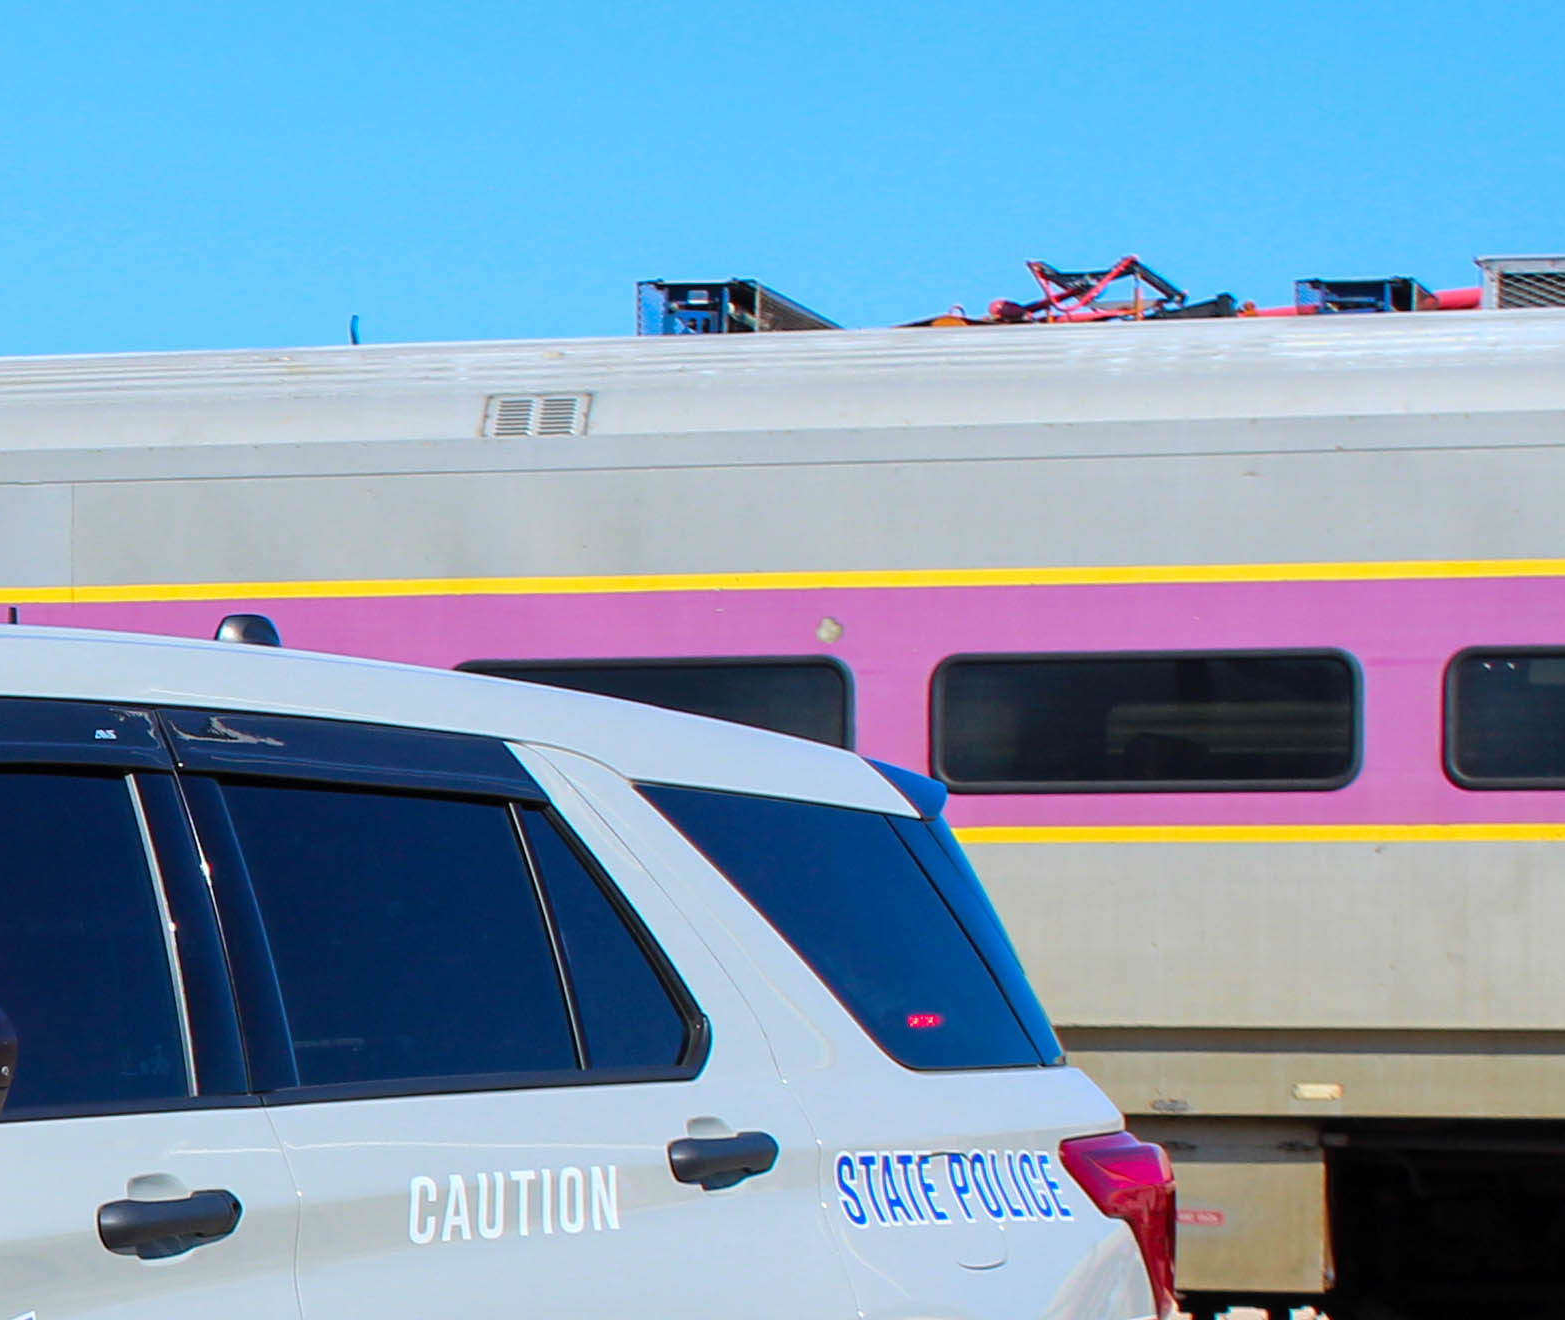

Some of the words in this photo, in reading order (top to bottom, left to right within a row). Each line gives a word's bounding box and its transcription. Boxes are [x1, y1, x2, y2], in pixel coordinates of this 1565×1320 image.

[408, 1165, 621, 1244] CAUTION
[835, 1150, 951, 1229] STATE
[946, 1149, 1074, 1223] POLICE
